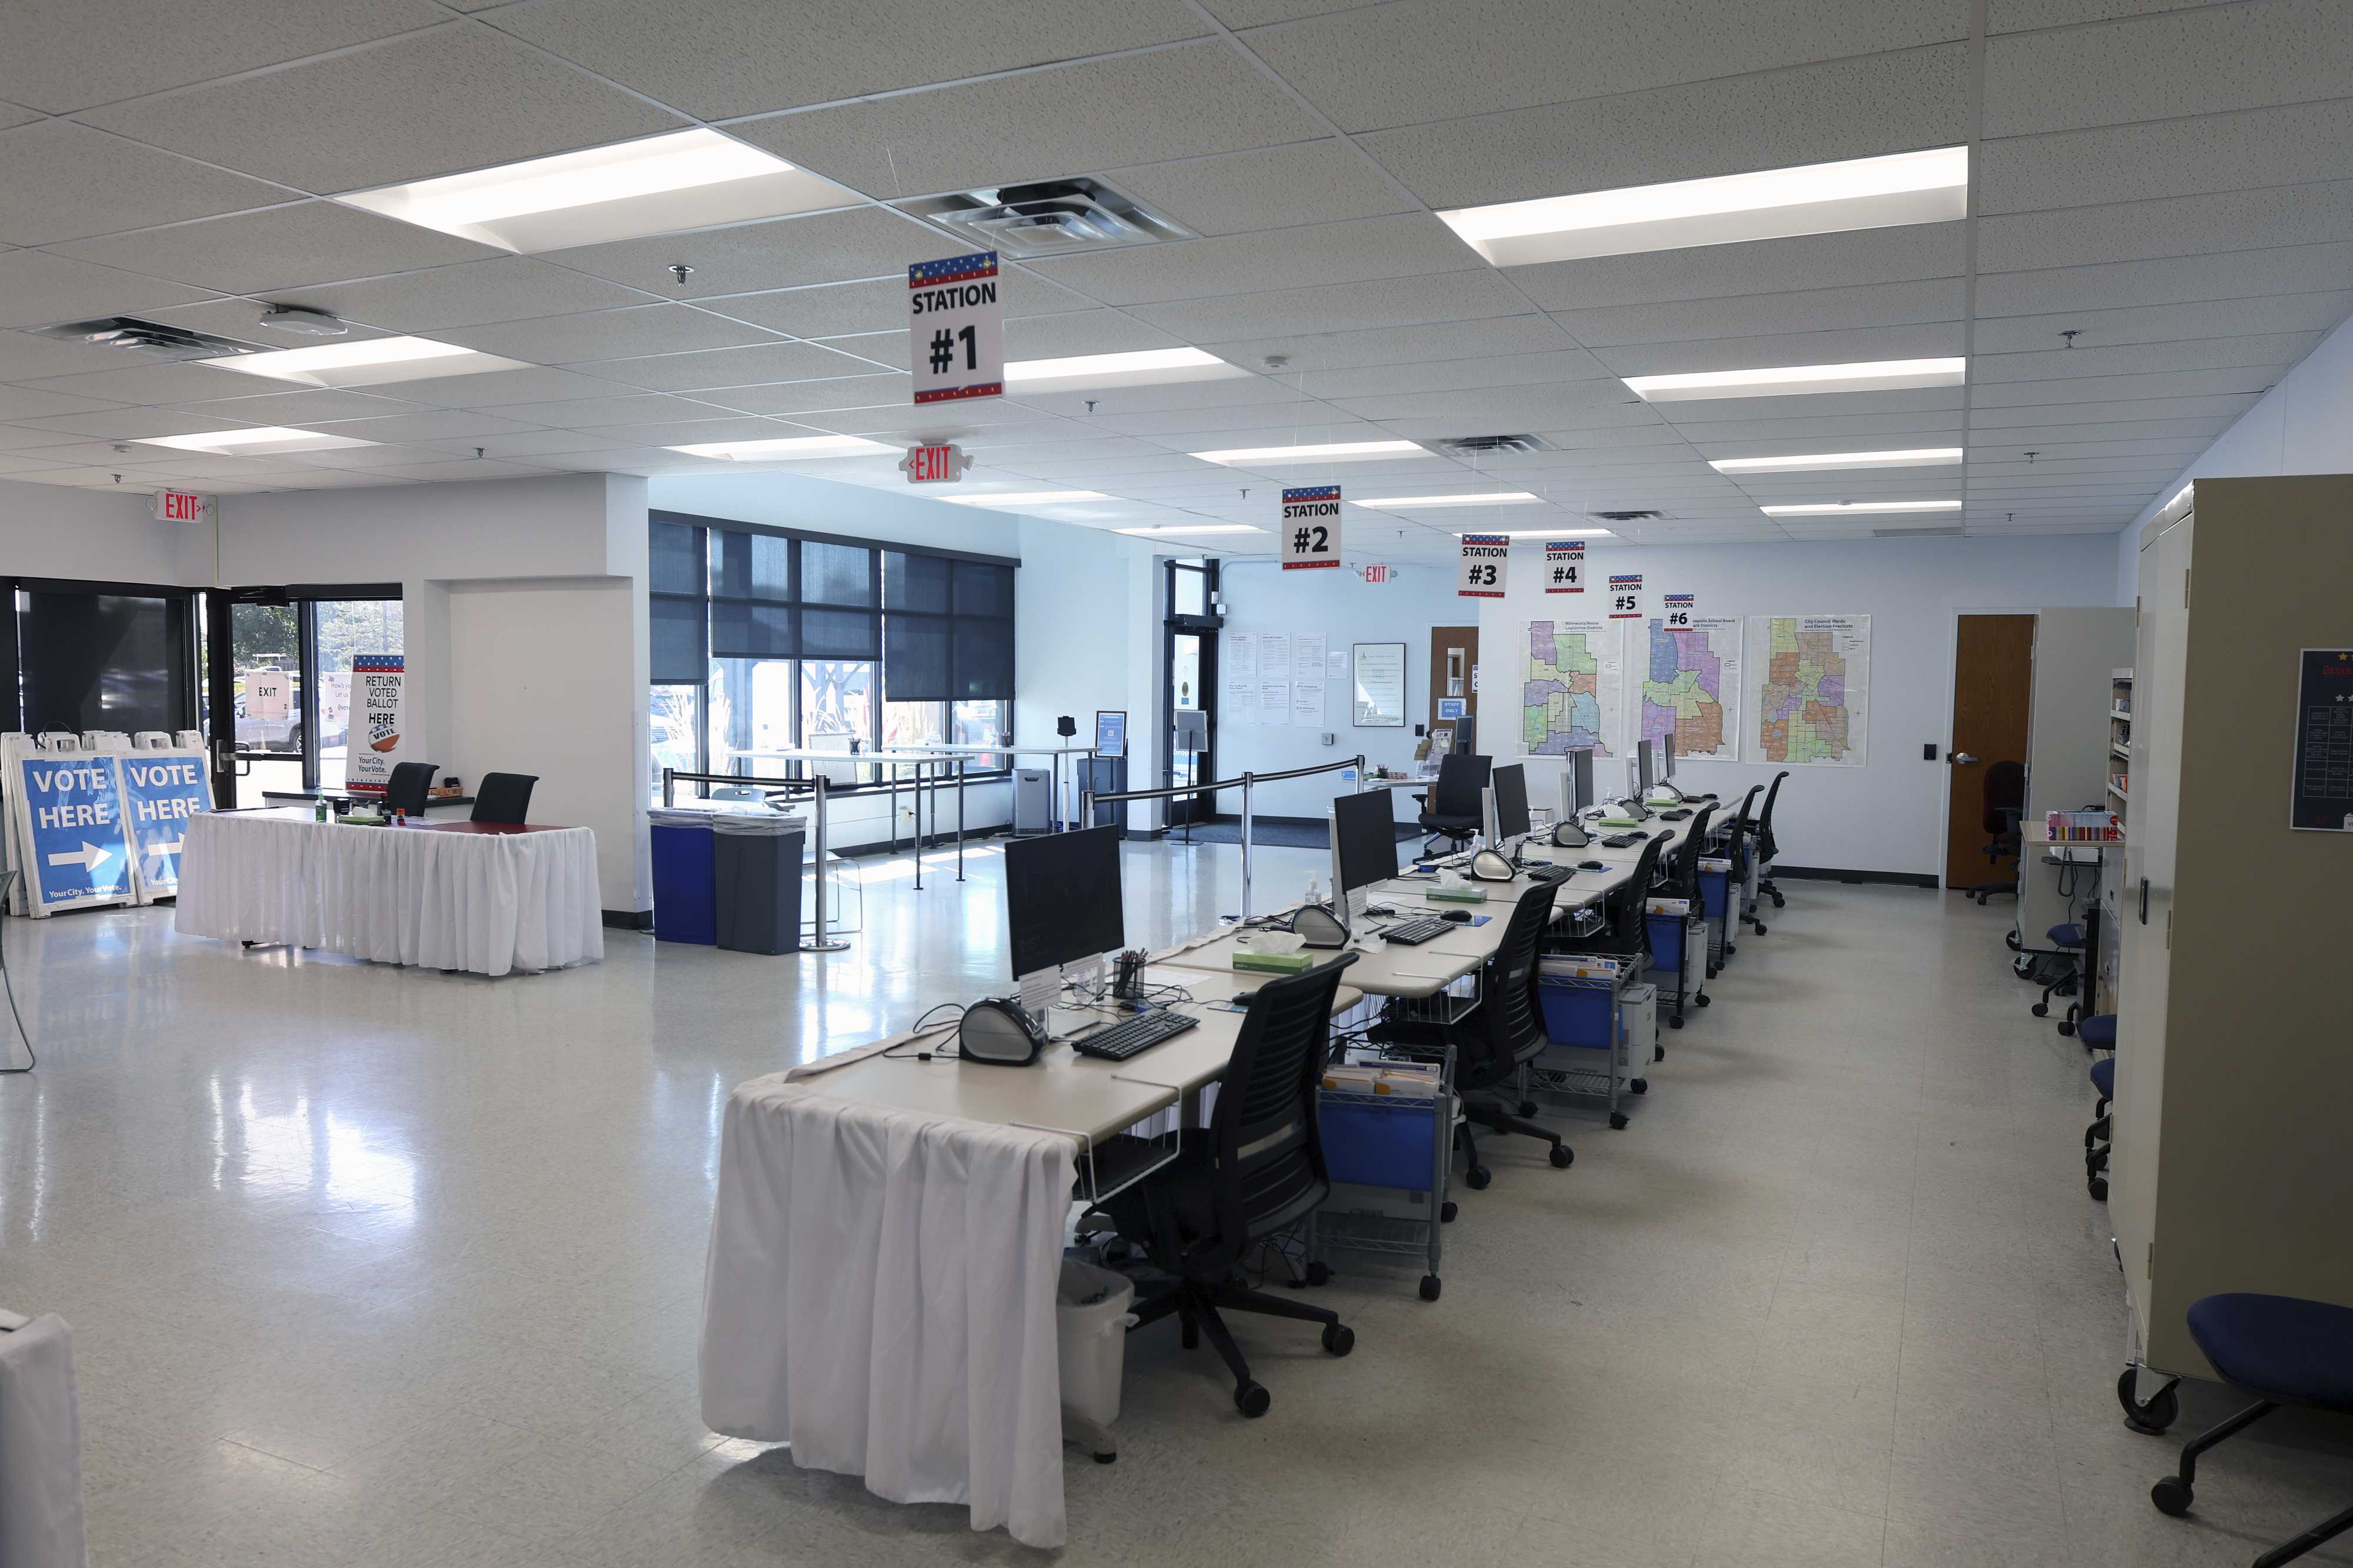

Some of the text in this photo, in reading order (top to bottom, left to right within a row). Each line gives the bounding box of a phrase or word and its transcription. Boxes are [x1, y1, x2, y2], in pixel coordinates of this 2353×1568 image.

[912, 282, 996, 314] STATION
[929, 325, 976, 374] #1
[915, 446, 951, 481] EXIT
[166, 493, 197, 520] EXIT
[1284, 503, 1338, 518] STATION
[1294, 526, 1328, 553] #2
[1462, 547, 1507, 558] STATION
[1547, 552, 1584, 561] STATION
[1366, 566, 1387, 582] EXIT
[1469, 565, 1497, 585] #3
[1553, 566, 1577, 583] #4
[1615, 596, 1635, 610] #5
[1669, 612, 1688, 625] #6
[2323, 665, 2353, 675] GENER
[366, 676, 401, 686] RETURN
[259, 687, 277, 697] EXIT
[369, 688, 397, 698] VOTED
[367, 699, 398, 708] BALLOT
[369, 713, 395, 724] HERE
[372, 728, 396, 740] VOTE
[1174, 749, 1189, 758] Drop
[372, 756, 385, 766] City.
[130, 765, 198, 787] VOTE
[372, 765, 386, 773] Vote.
[32, 768, 107, 792] VOTE
[39, 803, 110, 829] HERE
[136, 798, 201, 821] HERE
[49, 884, 121, 898] Your City. Your Vote.
